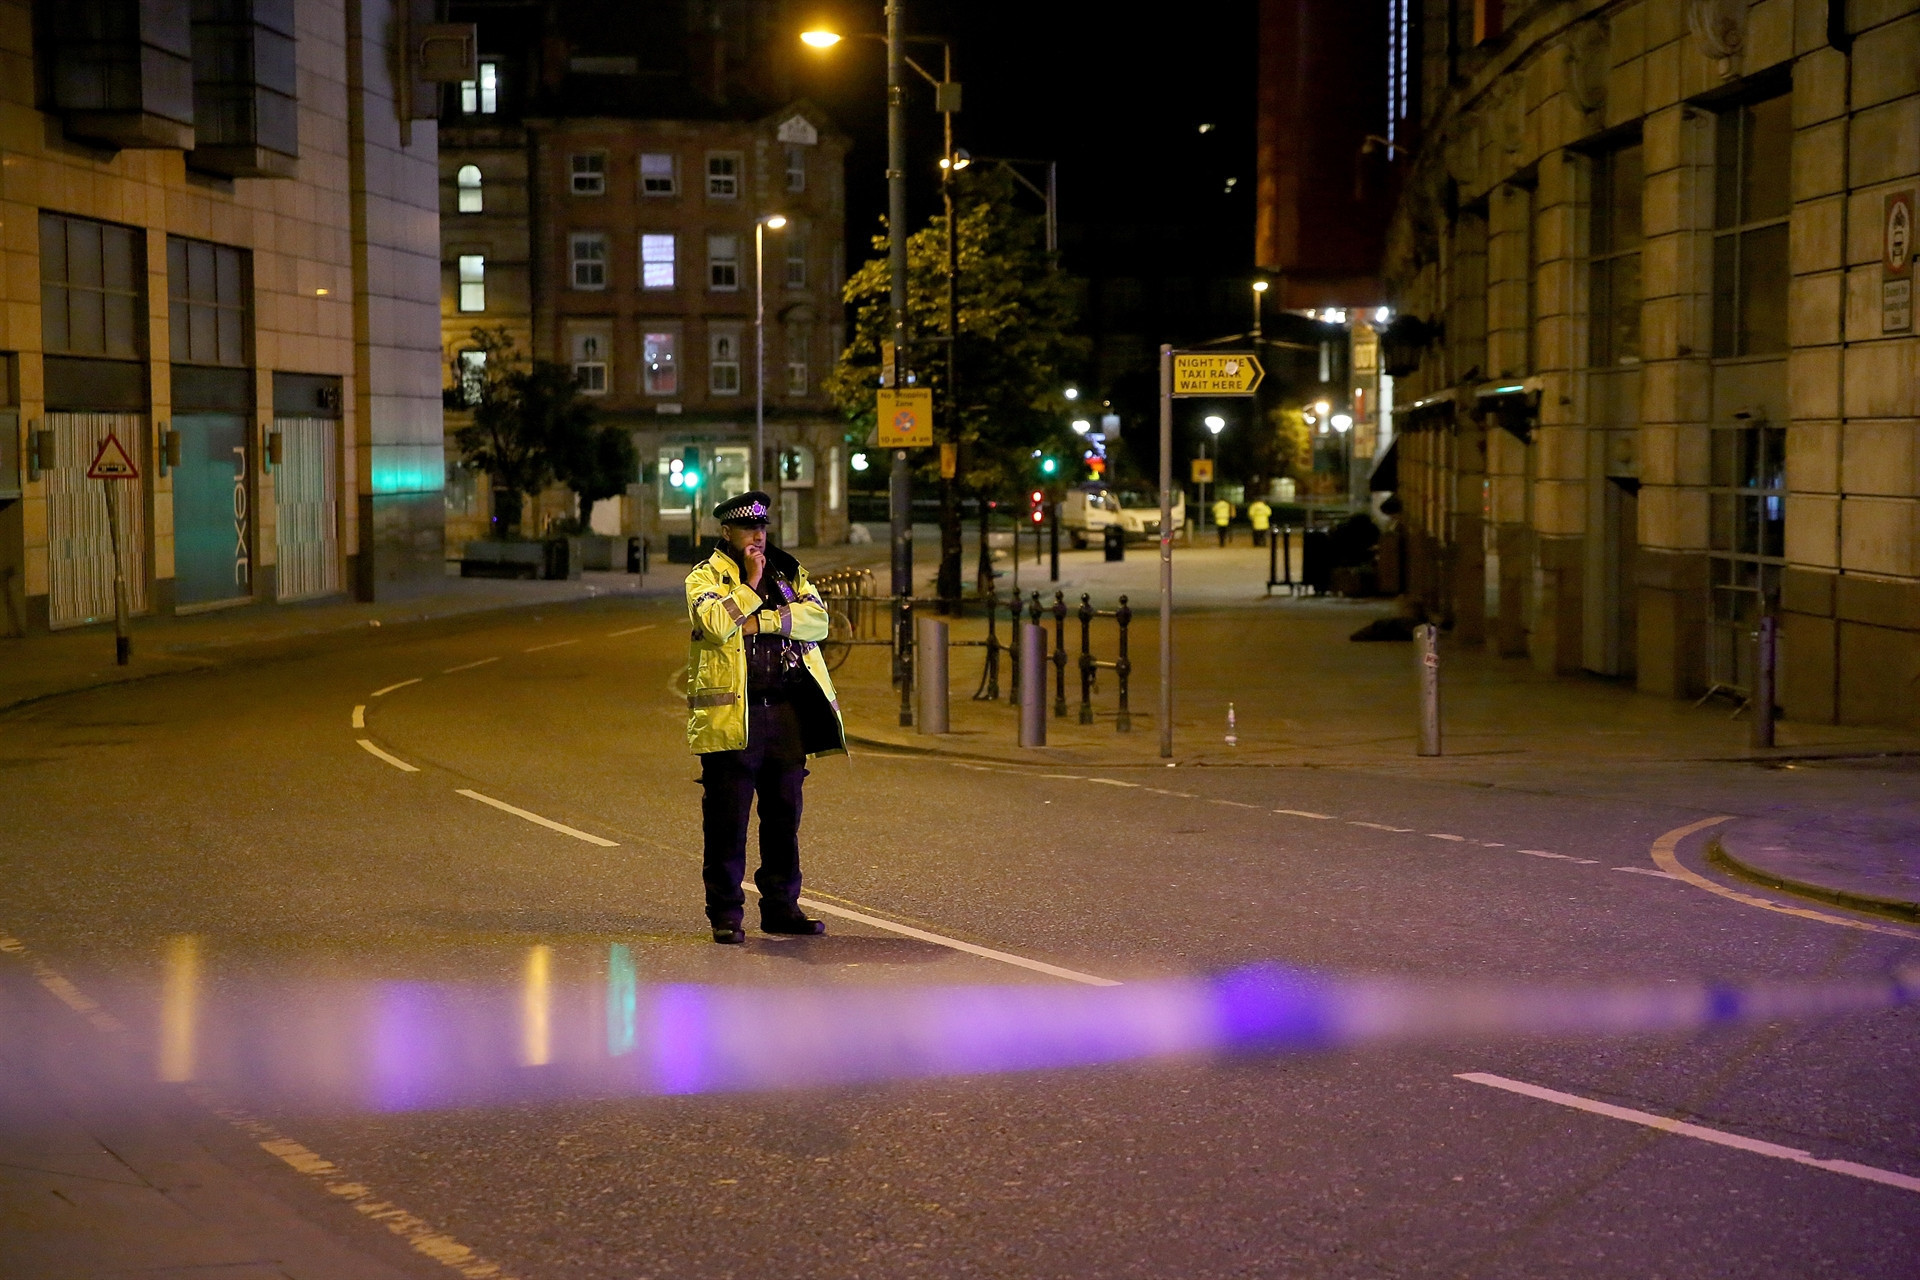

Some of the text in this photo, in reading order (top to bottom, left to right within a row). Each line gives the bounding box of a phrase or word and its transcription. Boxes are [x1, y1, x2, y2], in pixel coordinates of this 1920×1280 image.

[1178, 358, 1214, 367] NIGHT
[1181, 369, 1206, 378] TAXI
[1180, 380, 1243, 389] WAIT HERE
[895, 391, 928, 400] Stopping
[233, 446, 248, 586] next
